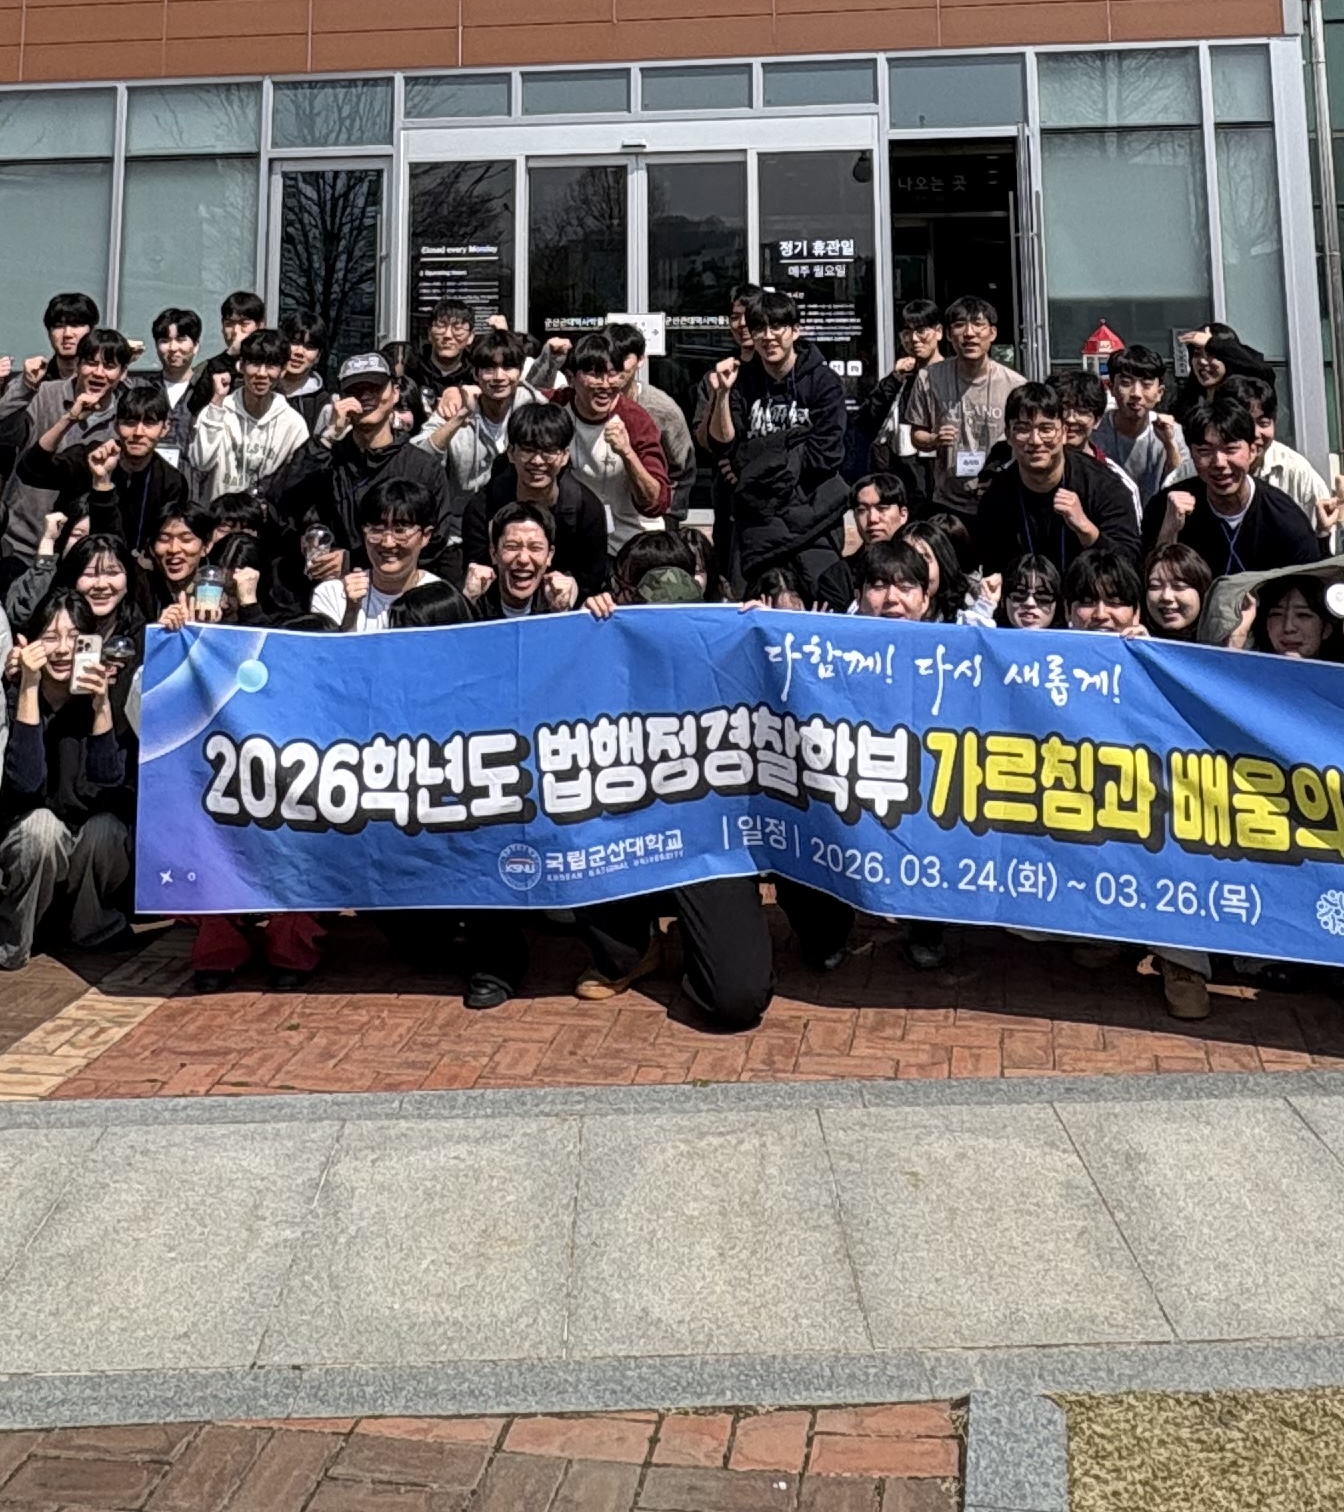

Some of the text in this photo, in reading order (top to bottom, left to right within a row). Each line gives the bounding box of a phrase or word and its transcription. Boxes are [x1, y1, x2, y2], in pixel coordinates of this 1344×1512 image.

[898, 175, 967, 191] 나오는 곳
[779, 239, 854, 257] 정기 휴관일
[788, 265, 846, 278] 매주 월요일
[764, 632, 1121, 716] 다함께! 다시 새롭게!
[203, 732, 526, 828] 2026학년도
[537, 705, 909, 817] 법행정경찰학부
[926, 730, 1157, 839] 가르침과
[545, 829, 684, 872] 국립군산대학교
[811, 837, 892, 885] 2026.
[900, 854, 948, 889] 03.
[958, 858, 1058, 902] 24.(화)
[1095, 872, 1146, 910] 03.
[1156, 878, 1262, 926] 26.(목)
